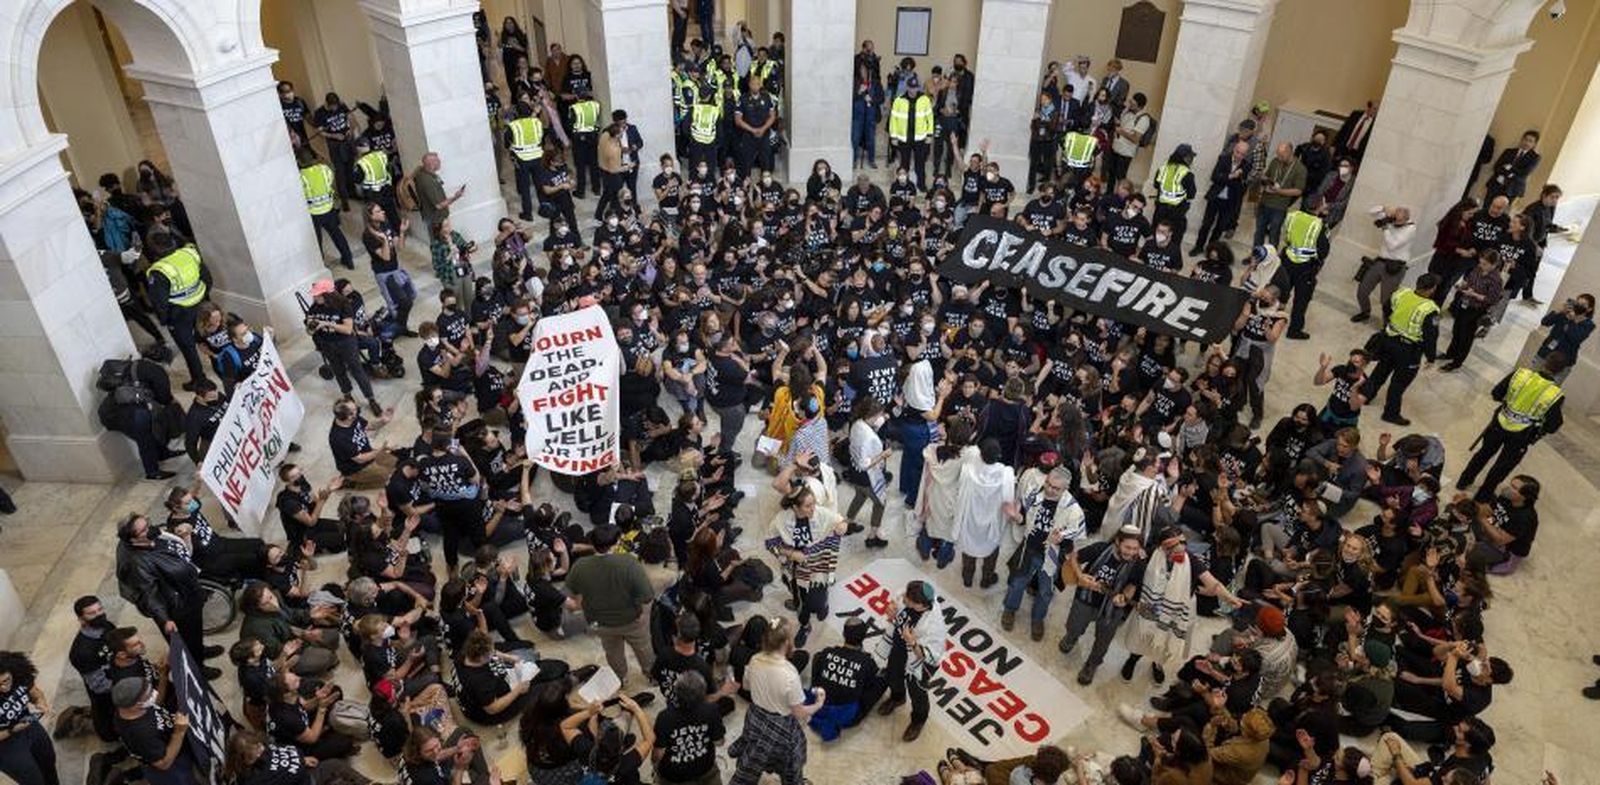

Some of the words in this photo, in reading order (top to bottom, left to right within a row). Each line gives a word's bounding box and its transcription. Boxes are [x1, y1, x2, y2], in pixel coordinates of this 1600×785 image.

[961, 229, 1209, 336] CEASEFIRE.
[536, 326, 604, 351] OURN
[542, 346, 585, 364] THE
[548, 372, 590, 393] AND
[533, 383, 609, 412] FIGHT
[546, 404, 603, 432] LIKE
[213, 414, 244, 486] PHILLY
[577, 432, 616, 458] THE
[424, 463, 458, 476] JEWS
[794, 526, 808, 535] OT
[825, 652, 848, 667] NOT
[848, 660, 862, 673] IN
[844, 573, 1051, 743] CEASRE
[821, 668, 858, 688] NAME
[828, 662, 854, 678] OUR
[16, 684, 29, 697] IN
[6, 694, 30, 721] OUR
[920, 664, 1005, 747] JEW
[670, 724, 709, 739] JEWS
[675, 732, 704, 746] SAY
[270, 749, 280, 772] NOT
